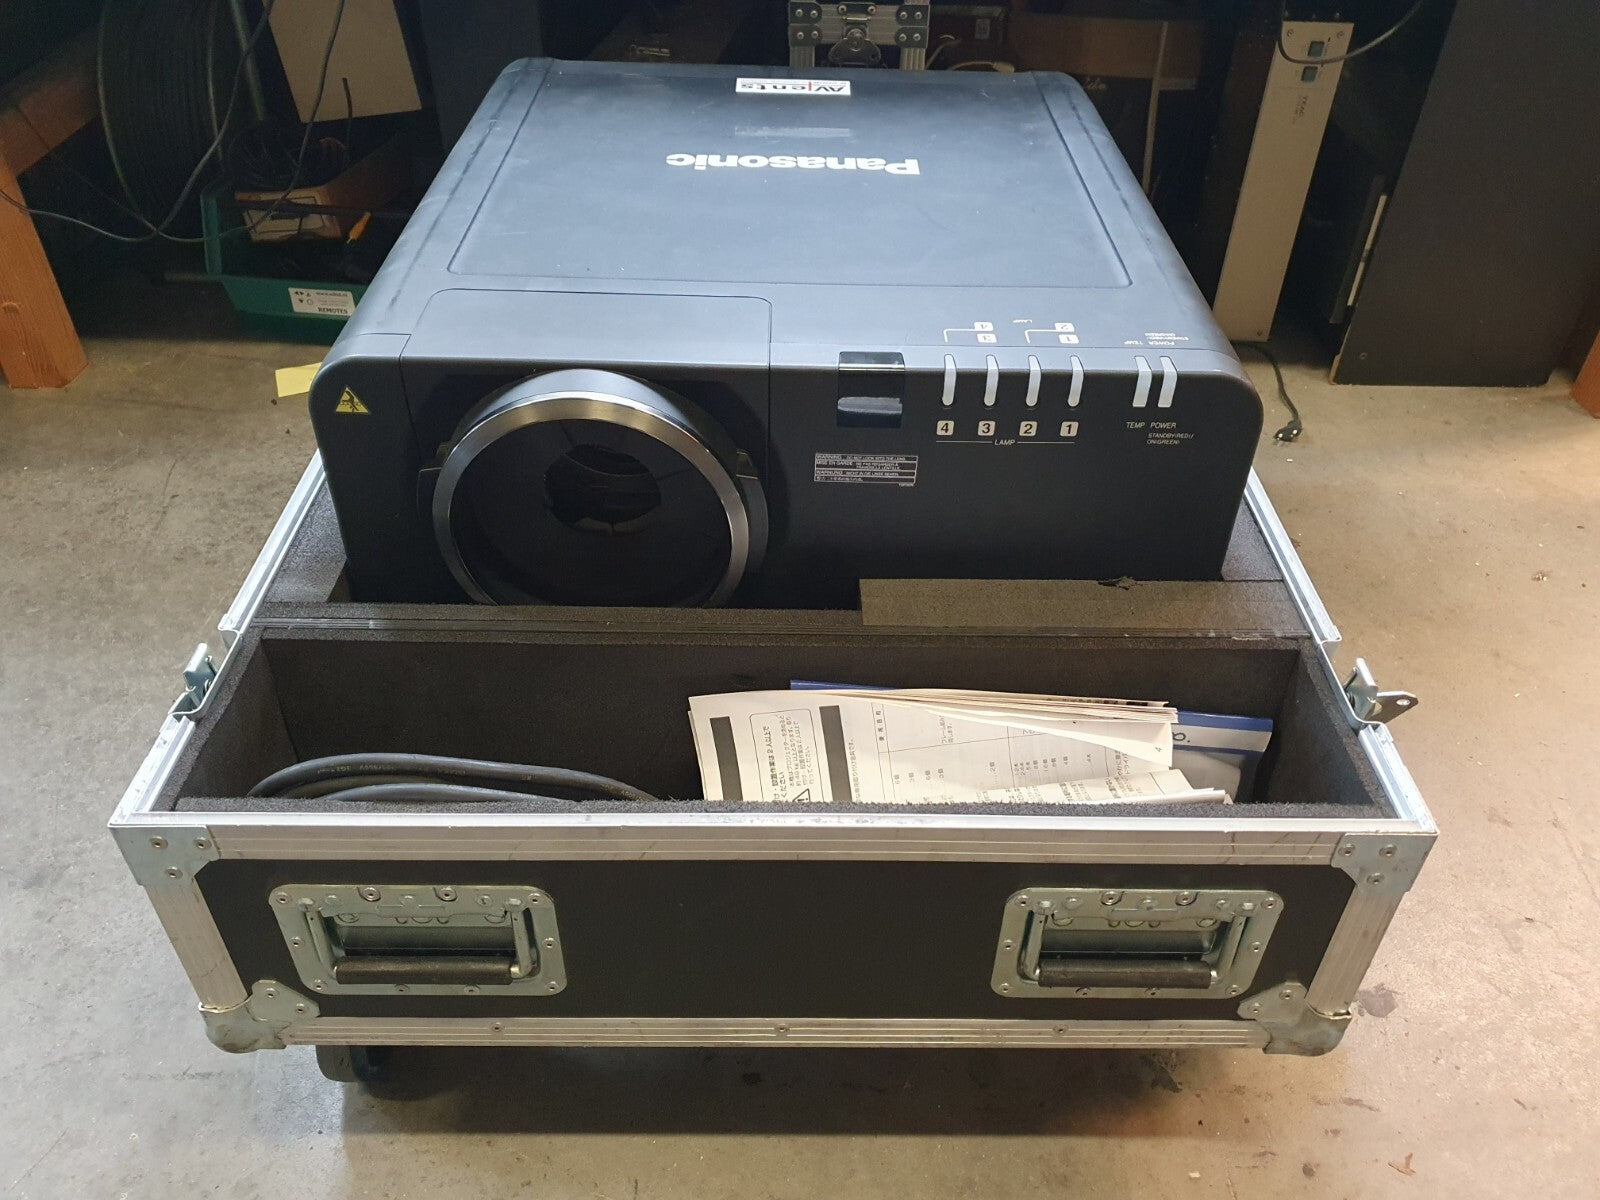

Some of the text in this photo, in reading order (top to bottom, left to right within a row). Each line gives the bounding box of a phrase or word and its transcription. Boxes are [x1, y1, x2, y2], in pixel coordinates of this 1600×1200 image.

[665, 153, 921, 175] Panasonic
[940, 422, 950, 433] 4
[981, 422, 992, 434] 3
[1022, 423, 1033, 435] 2
[1126, 421, 1177, 429] TEMP POWER
[994, 438, 1016, 446] LAMP
